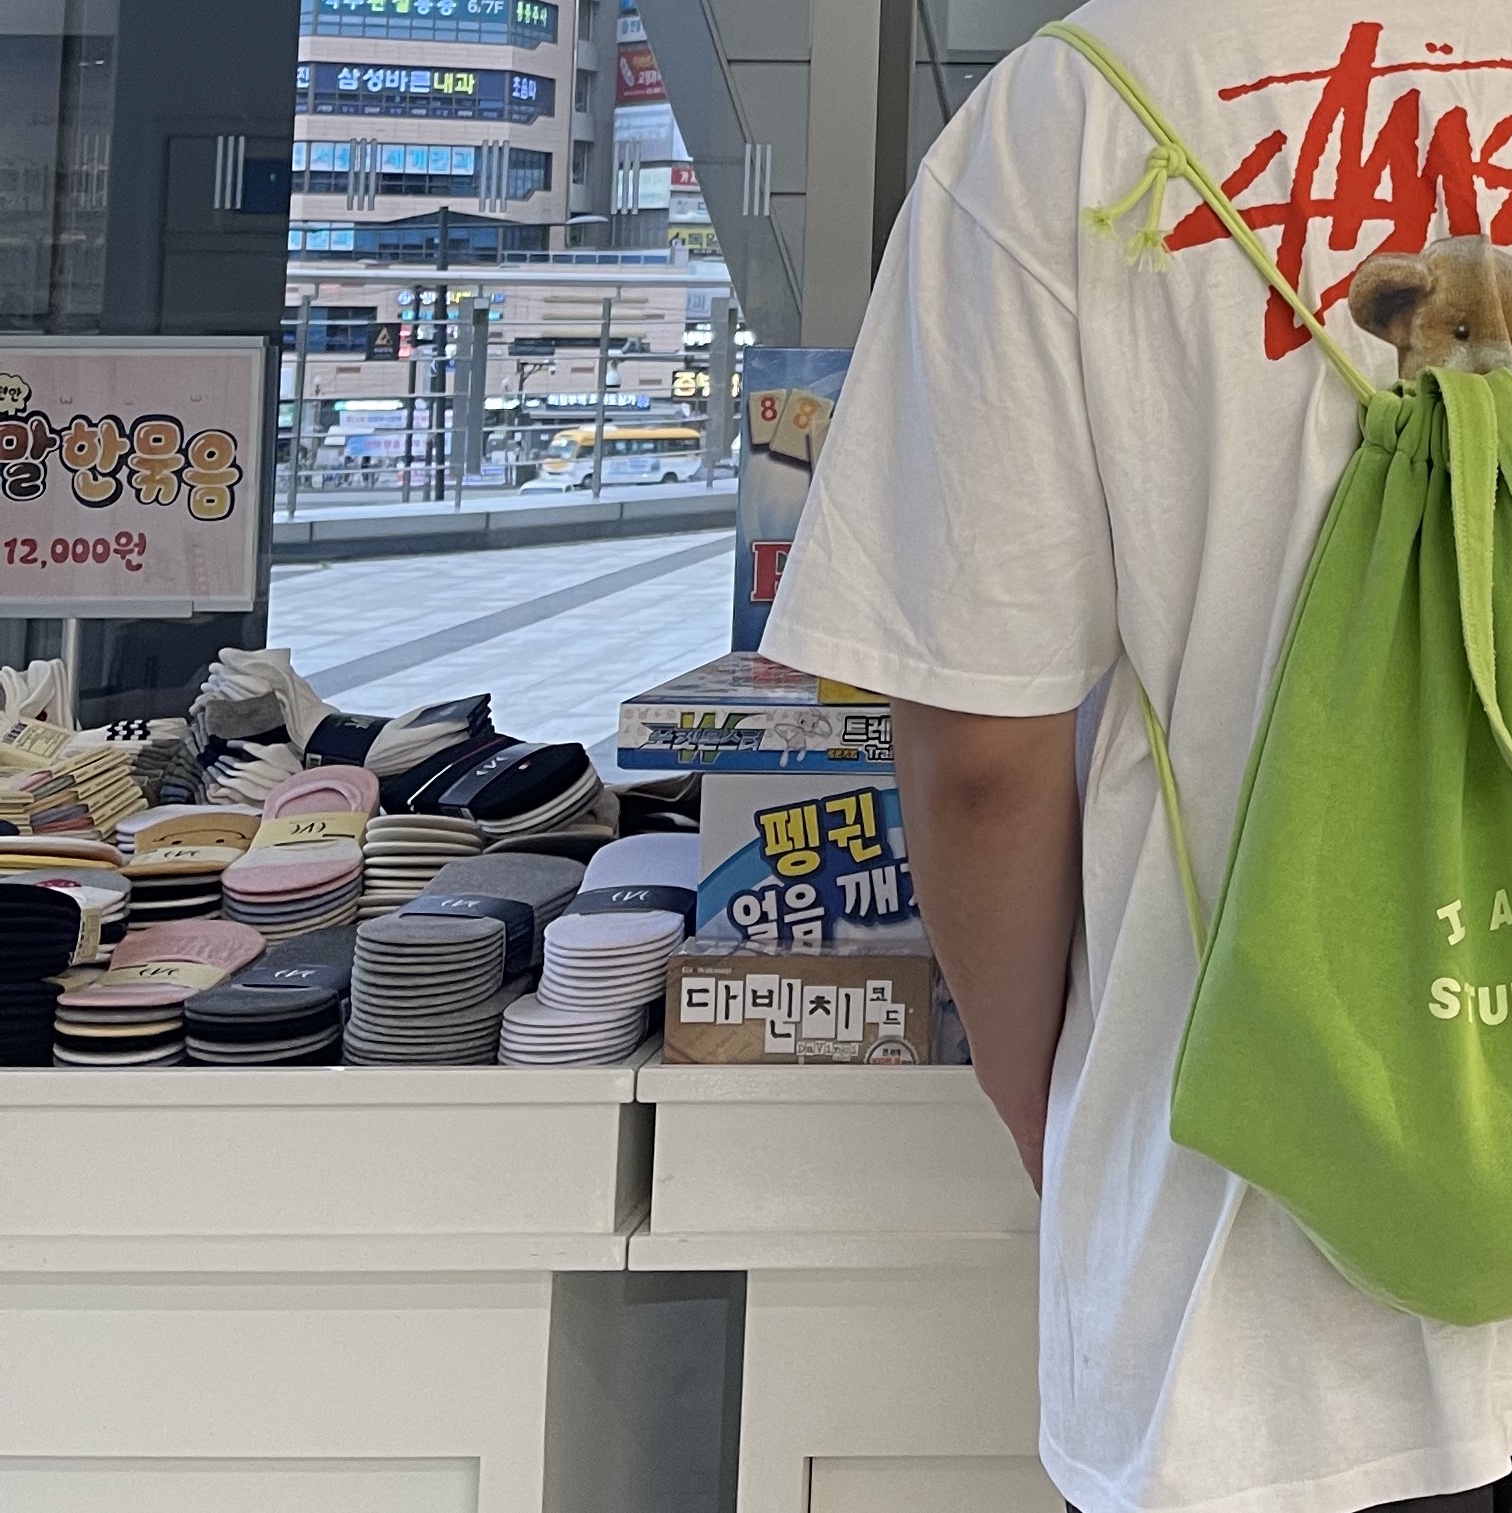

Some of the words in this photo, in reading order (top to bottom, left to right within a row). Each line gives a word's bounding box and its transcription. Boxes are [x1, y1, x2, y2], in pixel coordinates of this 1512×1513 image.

[337, 67, 475, 95] 삼성바른내과
[4, 531, 147, 572] 12,000원
[759, 791, 883, 878] 펭귄
